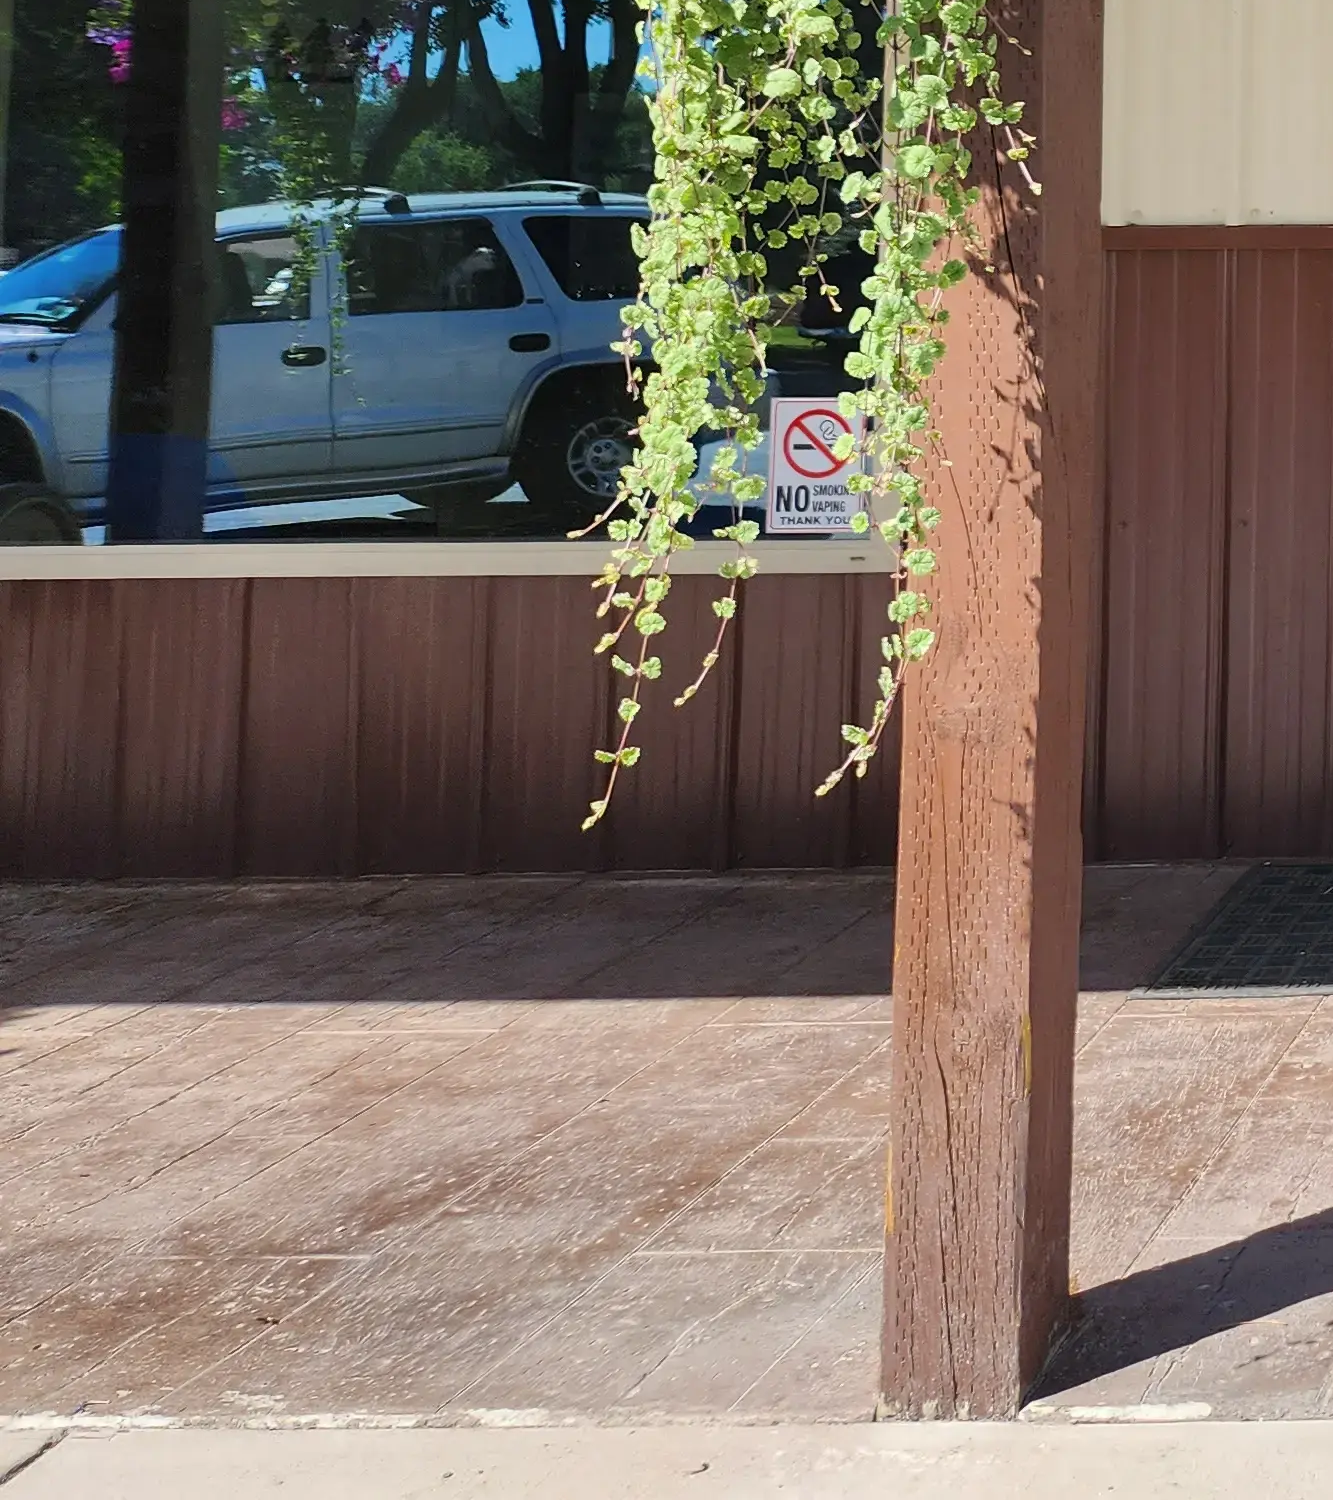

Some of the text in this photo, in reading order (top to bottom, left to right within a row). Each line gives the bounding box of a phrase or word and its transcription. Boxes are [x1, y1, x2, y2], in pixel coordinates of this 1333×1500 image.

[813, 484, 856, 496] SMOKIN
[776, 485, 810, 513] NO
[812, 500, 847, 513] VAPING
[780, 516, 821, 525] THANK
